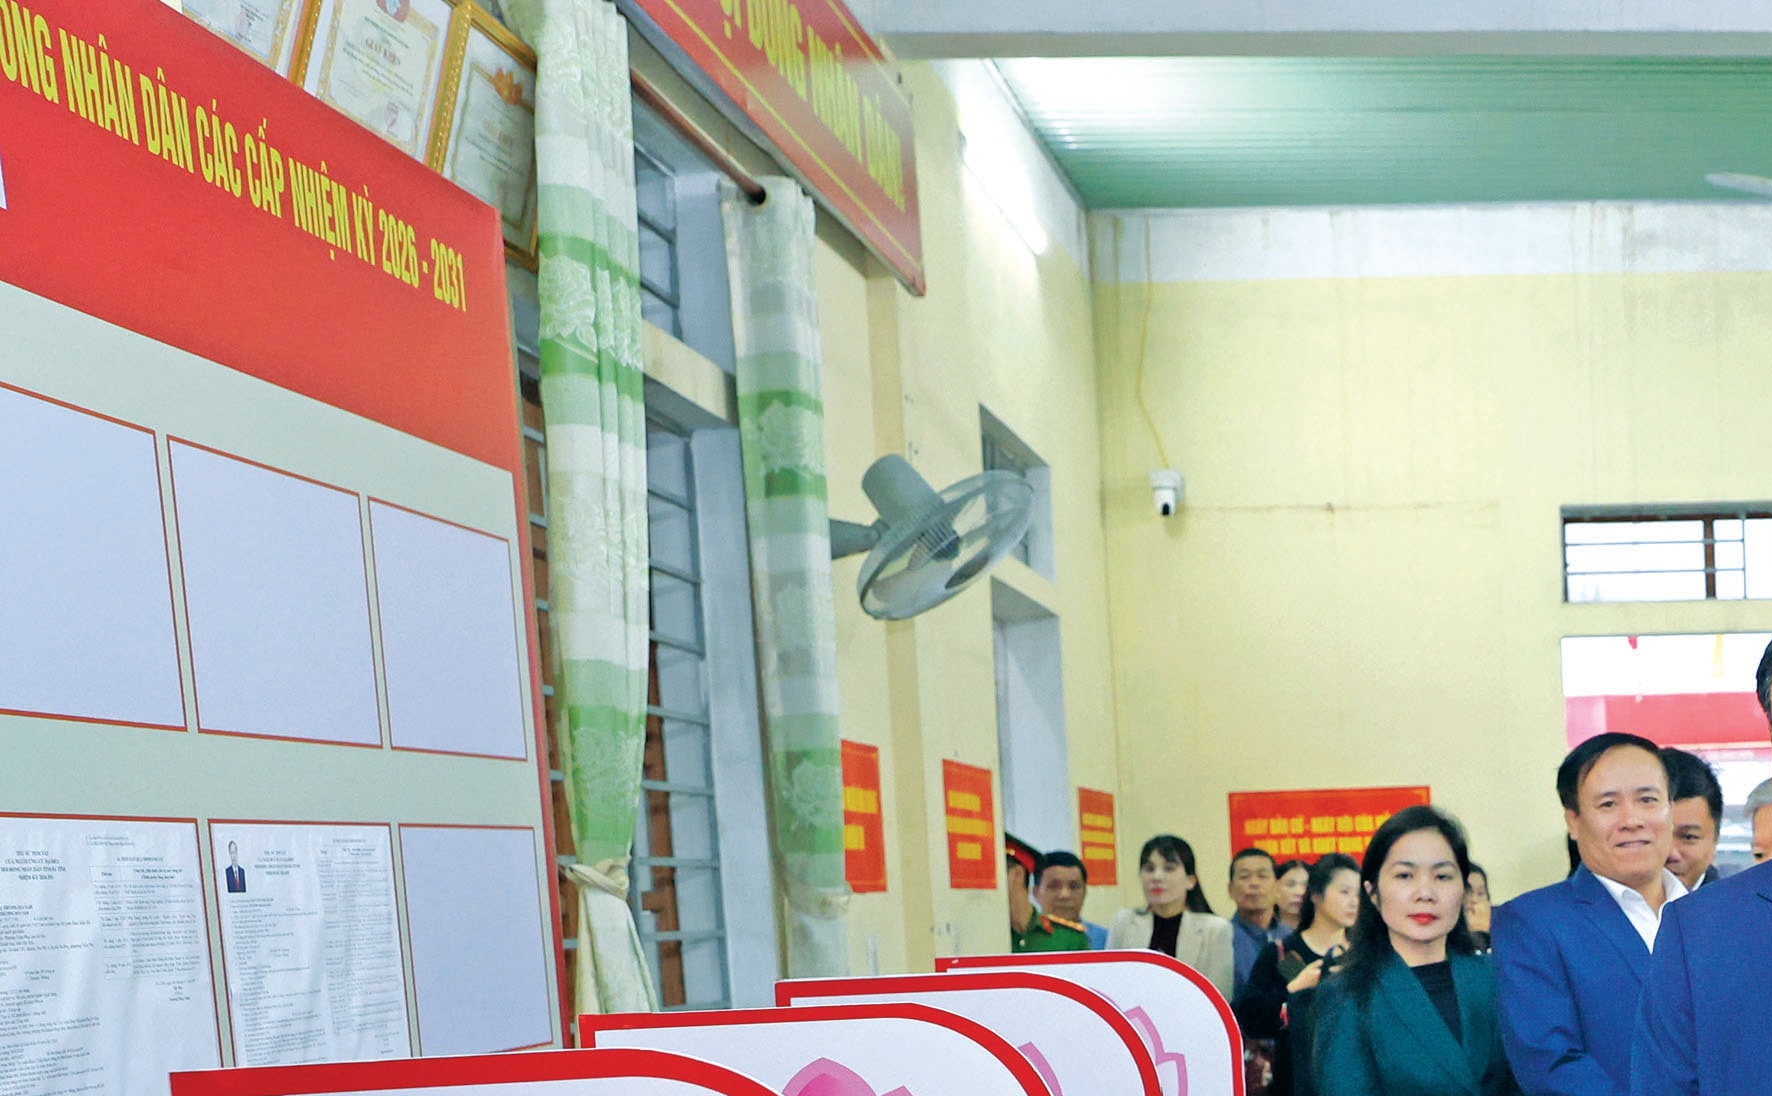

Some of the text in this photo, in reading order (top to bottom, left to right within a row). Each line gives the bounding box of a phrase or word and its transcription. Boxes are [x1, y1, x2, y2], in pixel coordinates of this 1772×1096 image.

[58, 27, 139, 146] NHÂN
[139, 66, 194, 174] DÂN
[195, 98, 242, 198] CÁC
[244, 117, 285, 218] CẤP
[288, 157, 352, 261] NHIỆM
[352, 184, 375, 266] KỲ
[378, 208, 420, 288] 2026
[430, 238, 467, 312] 2031
